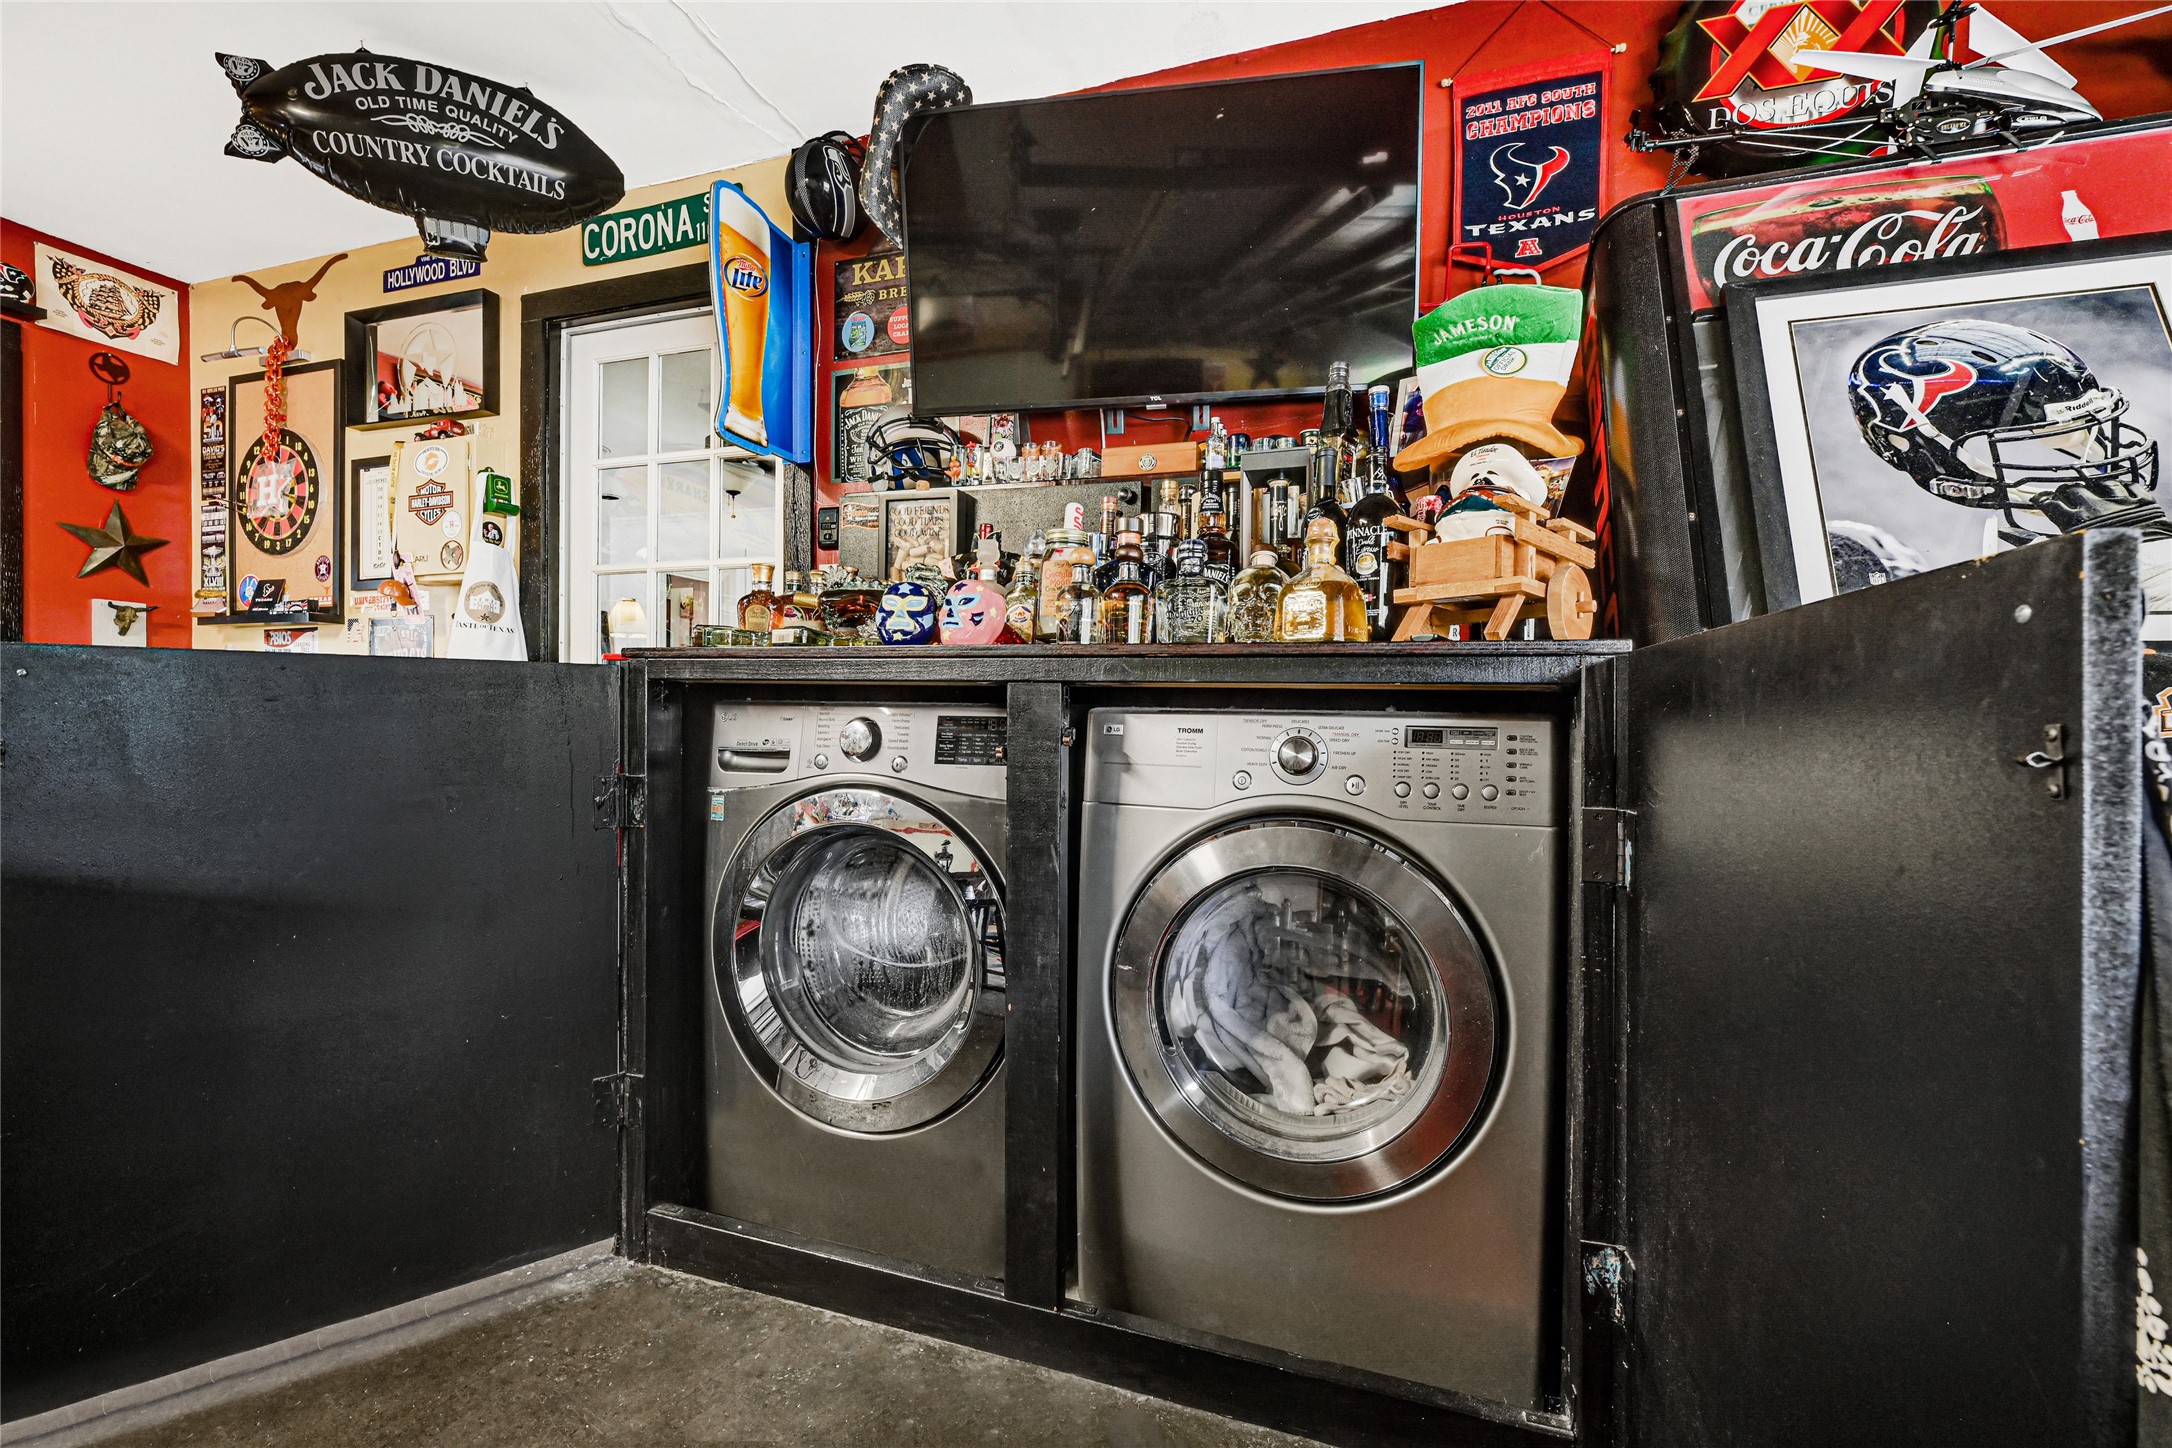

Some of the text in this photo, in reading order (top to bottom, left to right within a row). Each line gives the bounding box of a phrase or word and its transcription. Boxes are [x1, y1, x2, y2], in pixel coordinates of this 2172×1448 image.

[304, 62, 565, 149] JACK DANIEL'S
[1466, 83, 1596, 118] 2011 AFC SOUTH
[1708, 79, 1895, 131] DOS EQUIS
[355, 95, 519, 144] OLD TIME QUALITY
[1465, 100, 1596, 140] CHAMPIONS
[312, 129, 566, 200] COUNTRY COCKTAILS
[1498, 206, 1561, 221] HOUSTON
[1464, 208, 1596, 237] TEXANS
[583, 204, 694, 260] CORONA
[1714, 205, 1984, 289] Coca-Cola
[736, 257, 757, 271] Miller
[387, 259, 476, 289] HOLLYWOOD BLVD
[731, 267, 763, 292] Lite
[1434, 315, 1516, 346] JAMESON
[1494, 350, 1516, 371] OFFICIAL
[1500, 357, 1515, 371] DRINK
[2065, 398, 2094, 412] Riddell
[844, 412, 862, 430] JACK
[253, 446, 260, 455] 12
[295, 442, 302, 451] 18
[240, 475, 247, 483] 14
[308, 468, 315, 477] 13
[240, 492, 246, 500] 11
[420, 484, 442, 494] MOTOR
[308, 500, 315, 508] 10
[914, 505, 950, 515] FRIENDS
[304, 515, 310, 523] 15
[420, 509, 442, 521] CYCLES
[893, 516, 944, 526] GOOD TIMES
[894, 527, 942, 537] GOOD WINE
[264, 540, 270, 549] 19
[286, 538, 292, 547] 17
[489, 624, 515, 634] TEXAS
